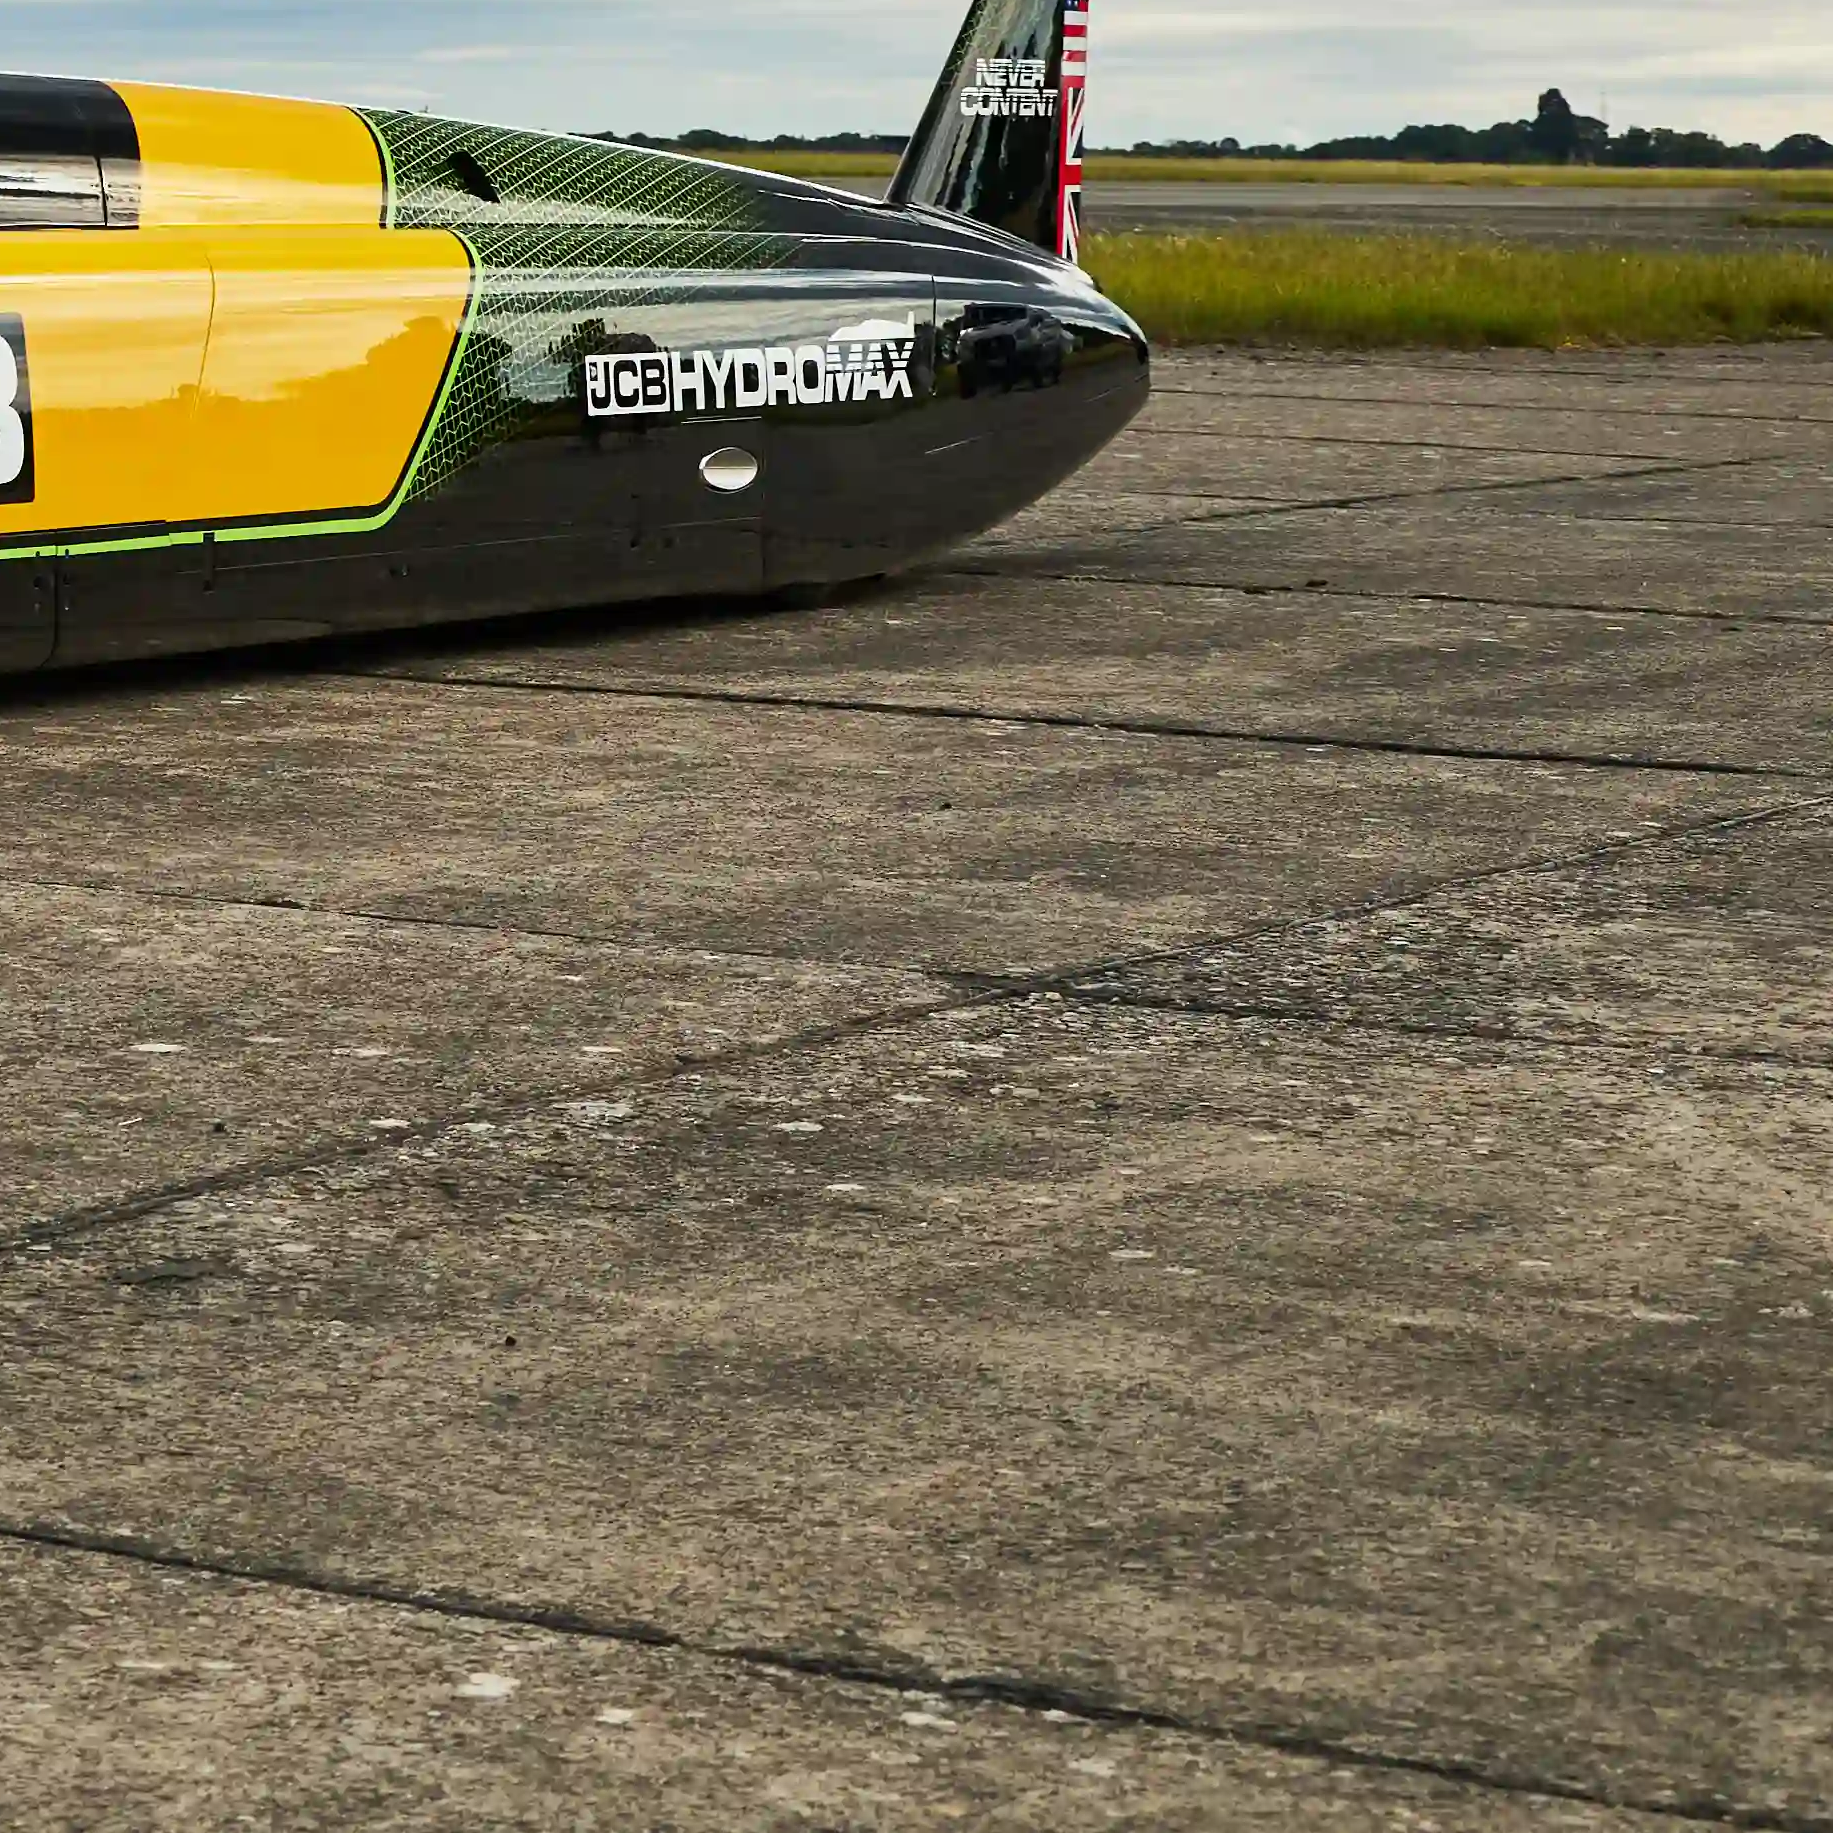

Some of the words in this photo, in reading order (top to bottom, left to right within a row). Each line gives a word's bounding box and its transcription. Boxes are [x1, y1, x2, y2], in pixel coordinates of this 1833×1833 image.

[976, 58, 1045, 87] NEVER
[961, 87, 1058, 116] CONTENT
[590, 358, 667, 409] JCB
[670, 341, 915, 412] HYDROMAX
